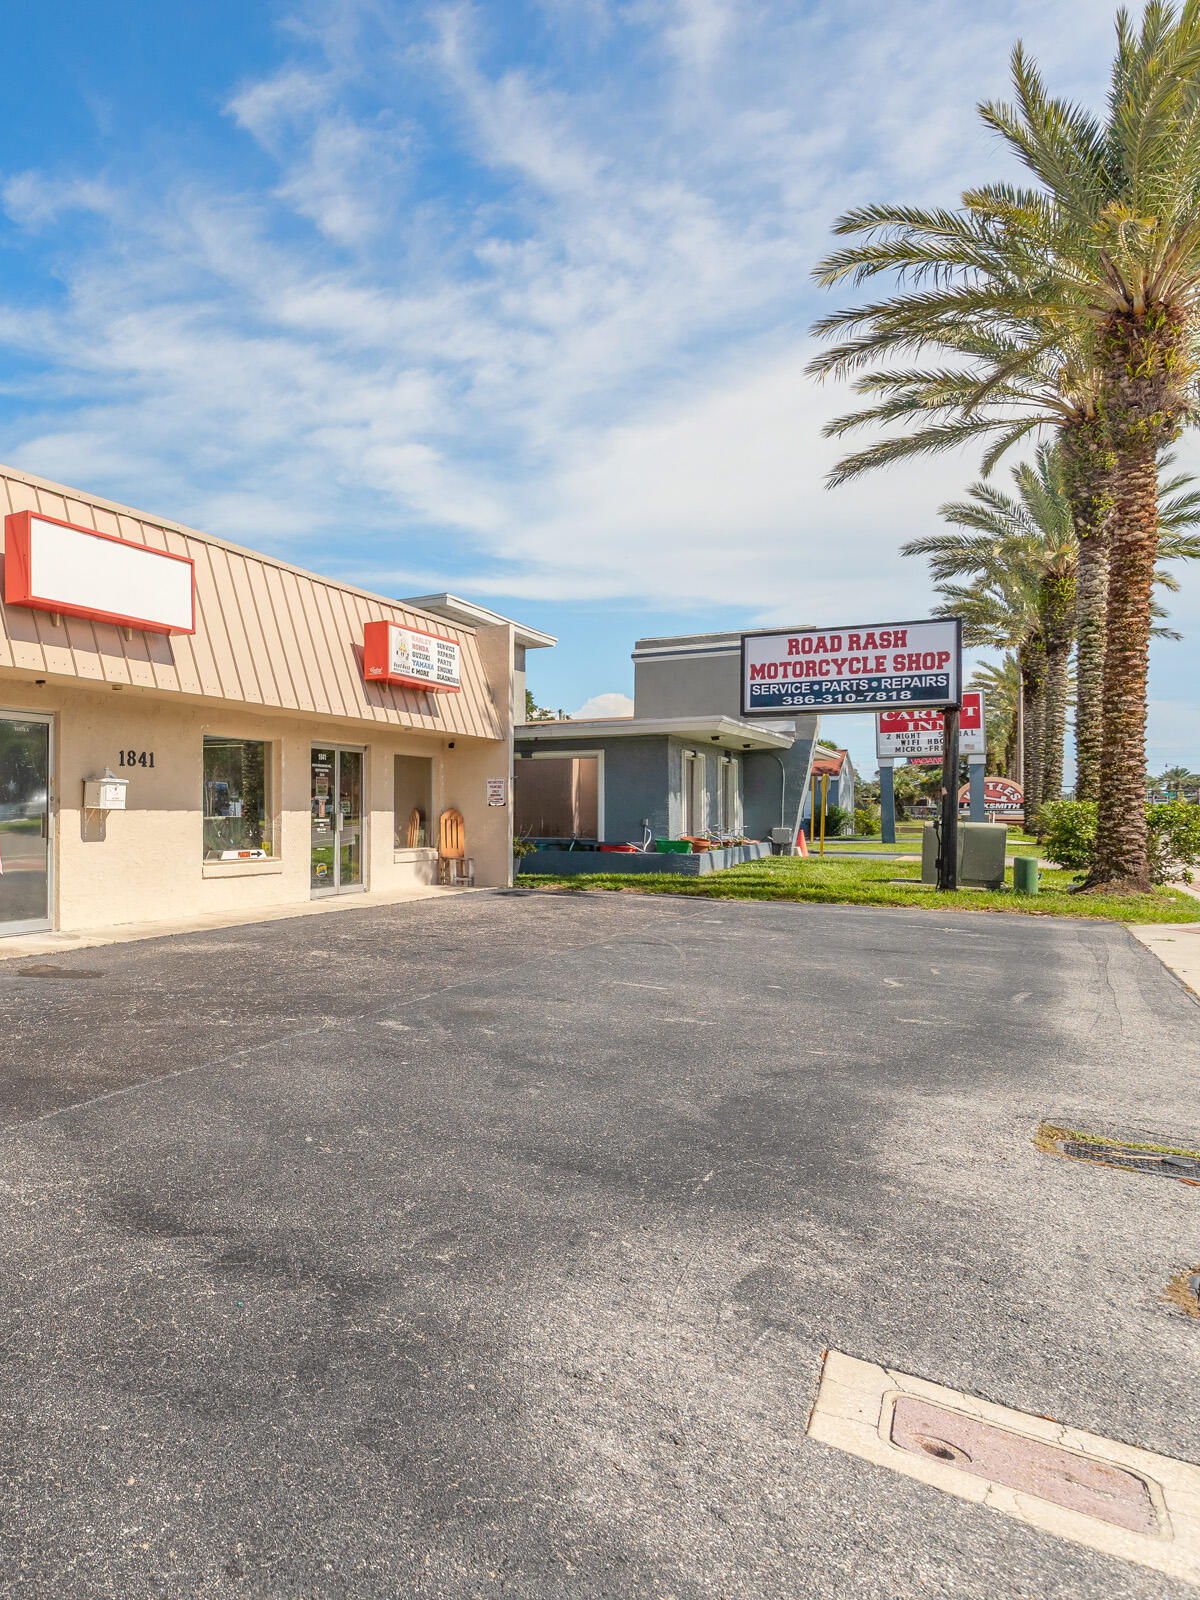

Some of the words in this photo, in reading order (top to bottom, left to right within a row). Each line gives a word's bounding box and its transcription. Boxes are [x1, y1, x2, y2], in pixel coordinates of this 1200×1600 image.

[787, 634, 842, 656] ROAD
[847, 629, 908, 652] RASH
[411, 659, 435, 670] YAMAHA
[437, 658, 452, 667] PARTS
[749, 655, 888, 681] MOTORCYCLE
[892, 651, 951, 672] SHOP
[415, 668, 430, 678] MORE
[752, 682, 811, 696] SERVICE
[822, 679, 869, 692] PARTS
[881, 675, 948, 689] REPAIRS
[781, 690, 912, 706] 386-310-7818
[895, 732, 921, 740] NIGHT
[118, 750, 155, 768] 1841
